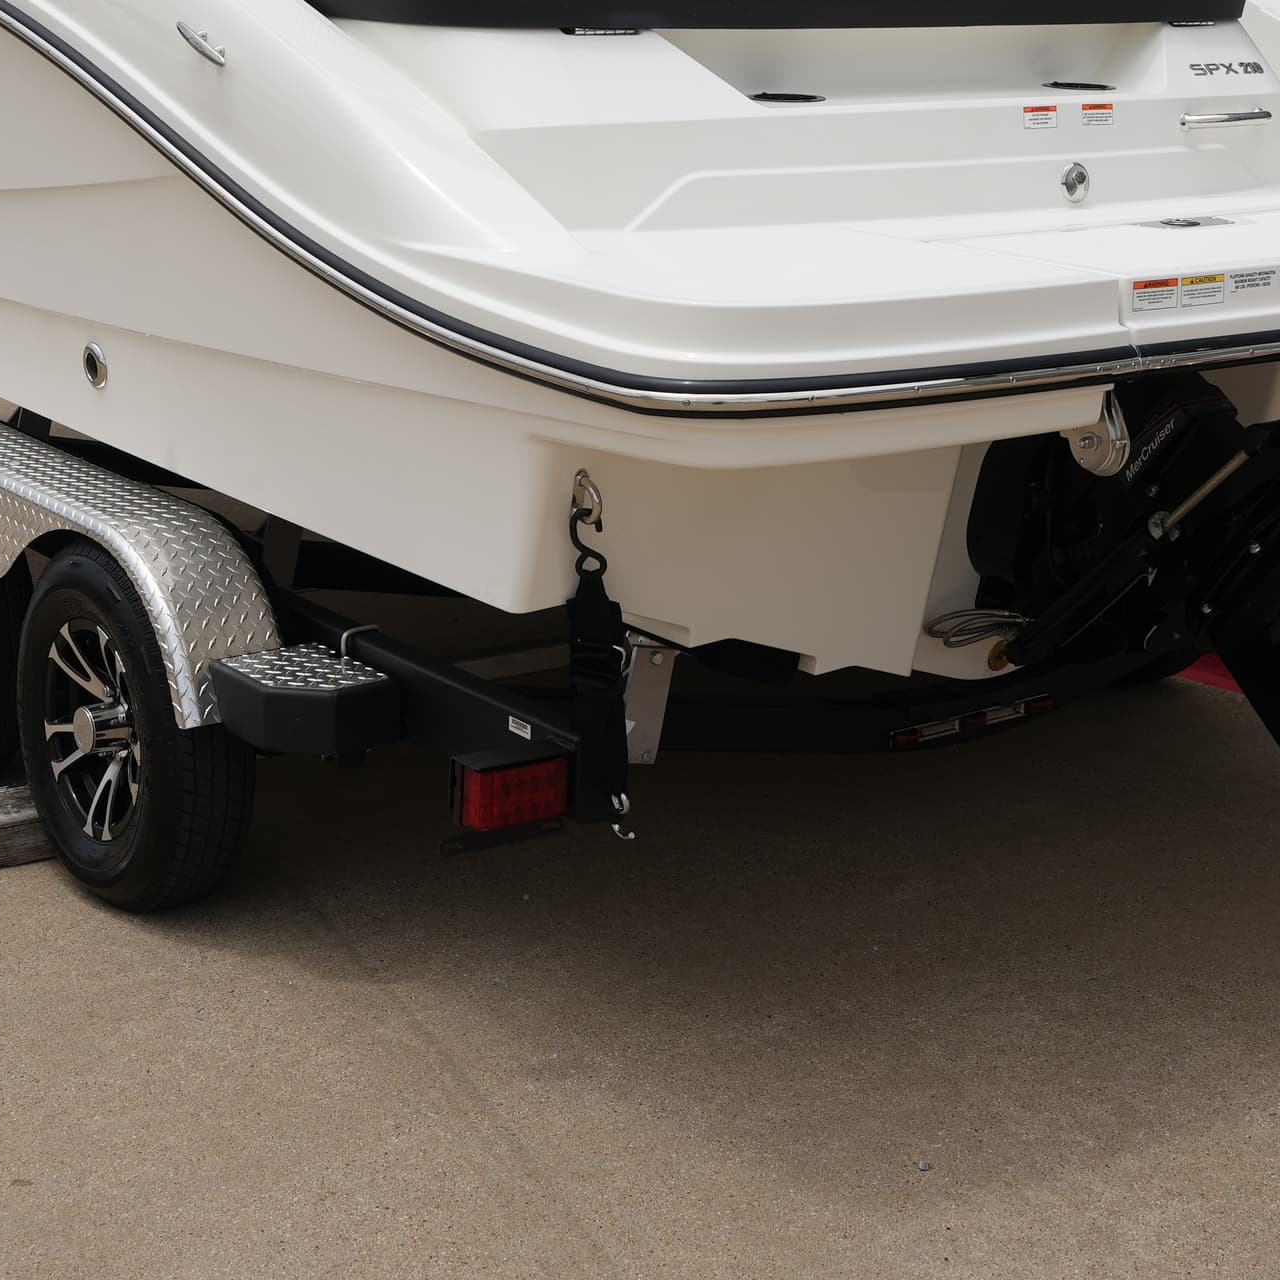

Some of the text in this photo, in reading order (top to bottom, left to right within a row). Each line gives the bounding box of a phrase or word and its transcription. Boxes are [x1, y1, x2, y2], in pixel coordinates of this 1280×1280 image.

[1189, 63, 1239, 76] SPX
[1195, 275, 1217, 284] CAUTION
[1125, 418, 1176, 482] MerCruiser
